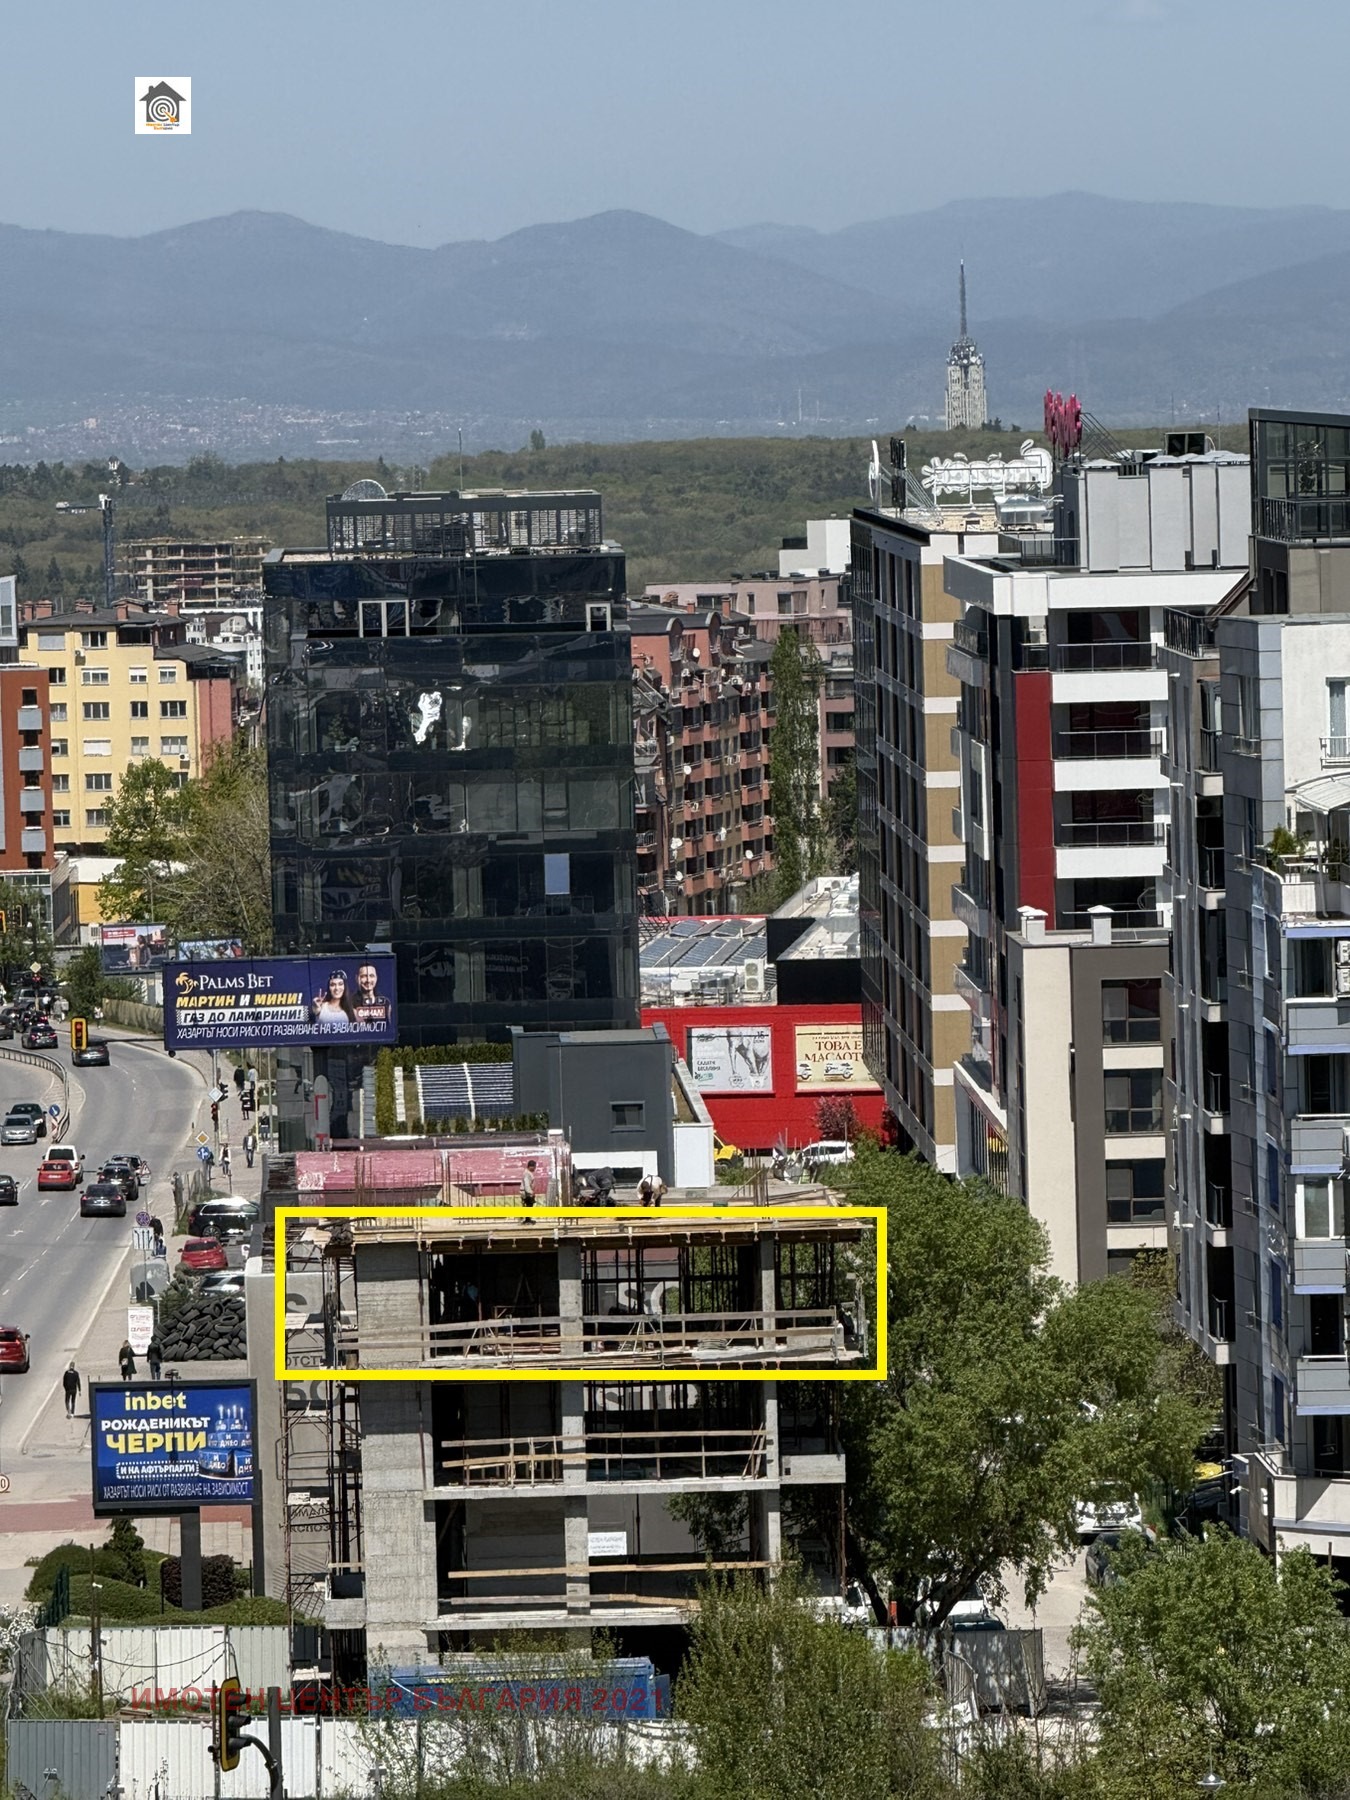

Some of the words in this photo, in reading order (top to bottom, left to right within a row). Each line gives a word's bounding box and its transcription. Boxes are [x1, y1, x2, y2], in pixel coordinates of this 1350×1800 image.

[199, 974, 245, 990] PALMS
[247, 973, 274, 989] BET
[176, 995, 236, 1008] МАРТИН
[240, 994, 250, 1006] И
[254, 992, 303, 1006] МИНИ!
[183, 1013, 205, 1024] ГАЗ
[208, 1011, 226, 1023] ДО
[229, 1009, 302, 1022] ЛАМАРИНИ!
[177, 1026, 216, 1039] ХАЗАРТЪТ
[216, 1025, 239, 1038] НОСИ
[240, 1025, 260, 1037] РИСК
[261, 1025, 273, 1036] ОТ
[273, 1023, 319, 1036] РАЗВИВАНЕ
[320, 1023, 331, 1034] НА
[815, 1041, 851, 1051] ТОВА
[805, 1052, 863, 1062] МАСЛОТ
[125, 1391, 187, 1411] inbet
[101, 1417, 211, 1432] РОЖДЕНИКЪТ
[106, 1431, 206, 1454] ЧЕРПИ
[120, 1467, 127, 1475] И
[128, 1466, 140, 1474] НА
[141, 1464, 195, 1474] АФТЪРПАРТИ
